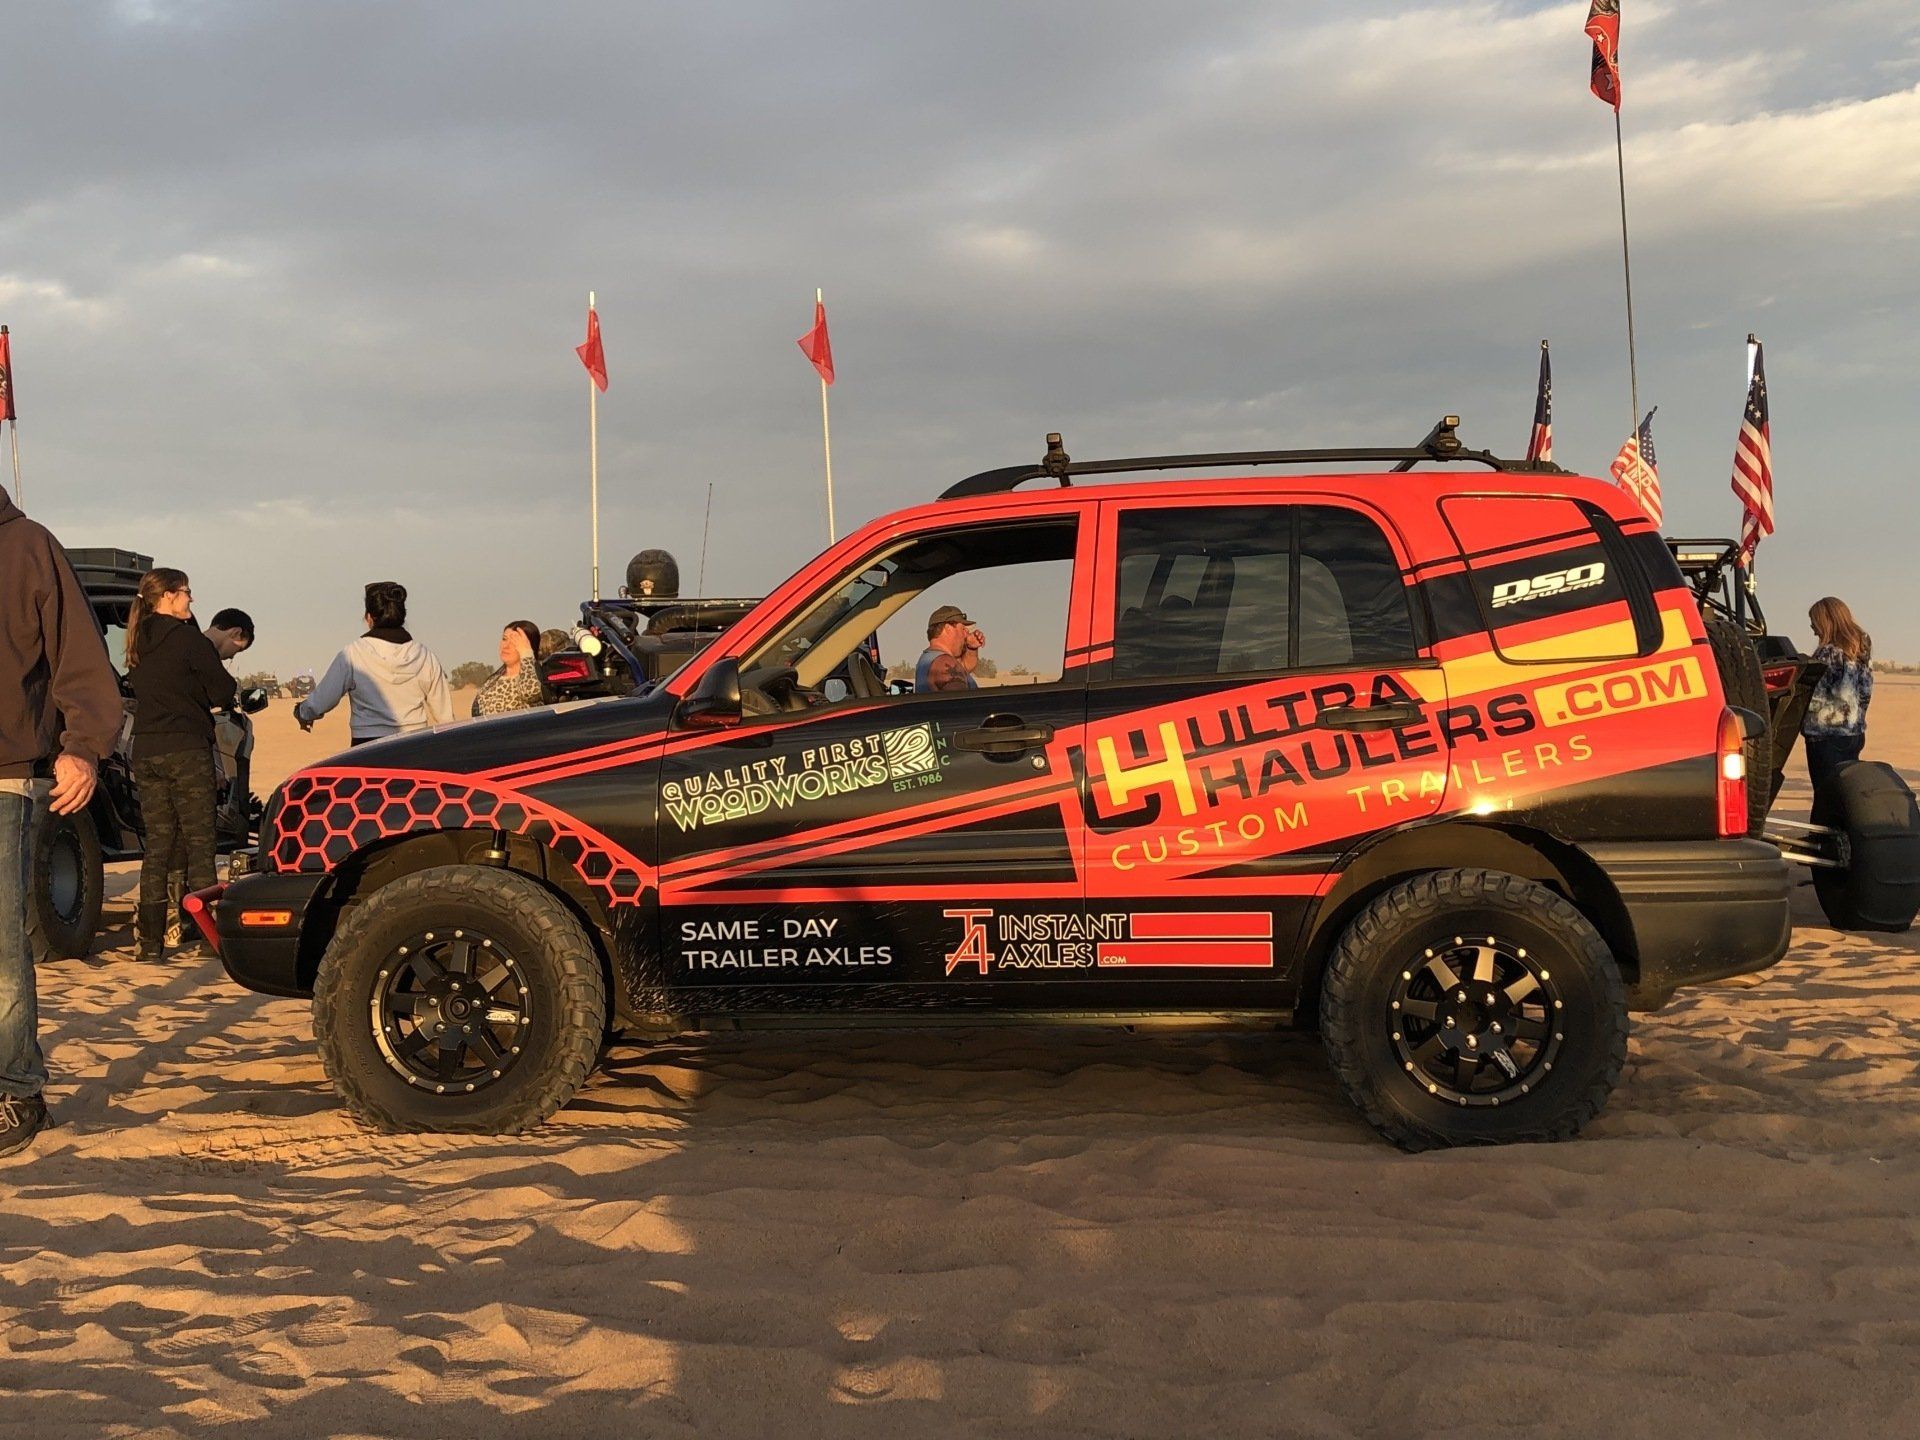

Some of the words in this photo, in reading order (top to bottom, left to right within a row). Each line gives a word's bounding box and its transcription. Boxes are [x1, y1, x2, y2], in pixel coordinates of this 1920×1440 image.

[1186, 674, 1428, 749] ULTRA
[662, 756, 787, 801] QUALITY
[802, 734, 880, 769] FIRST
[1199, 693, 1535, 808] HAULERS
[665, 755, 888, 832] WOODWORKS
[893, 778, 915, 793] EST.
[918, 772, 943, 788] 1986
[1111, 802, 1310, 871] CUSTOM
[1347, 735, 1594, 812] TRAILERS
[681, 920, 760, 941] SAME
[783, 918, 838, 939] DAY
[999, 914, 1127, 940] INSTANT
[681, 948, 799, 969] TRAILER
[804, 946, 892, 966] AXLES
[998, 943, 1094, 969] AXLES
[1100, 955, 1127, 965] .COM
